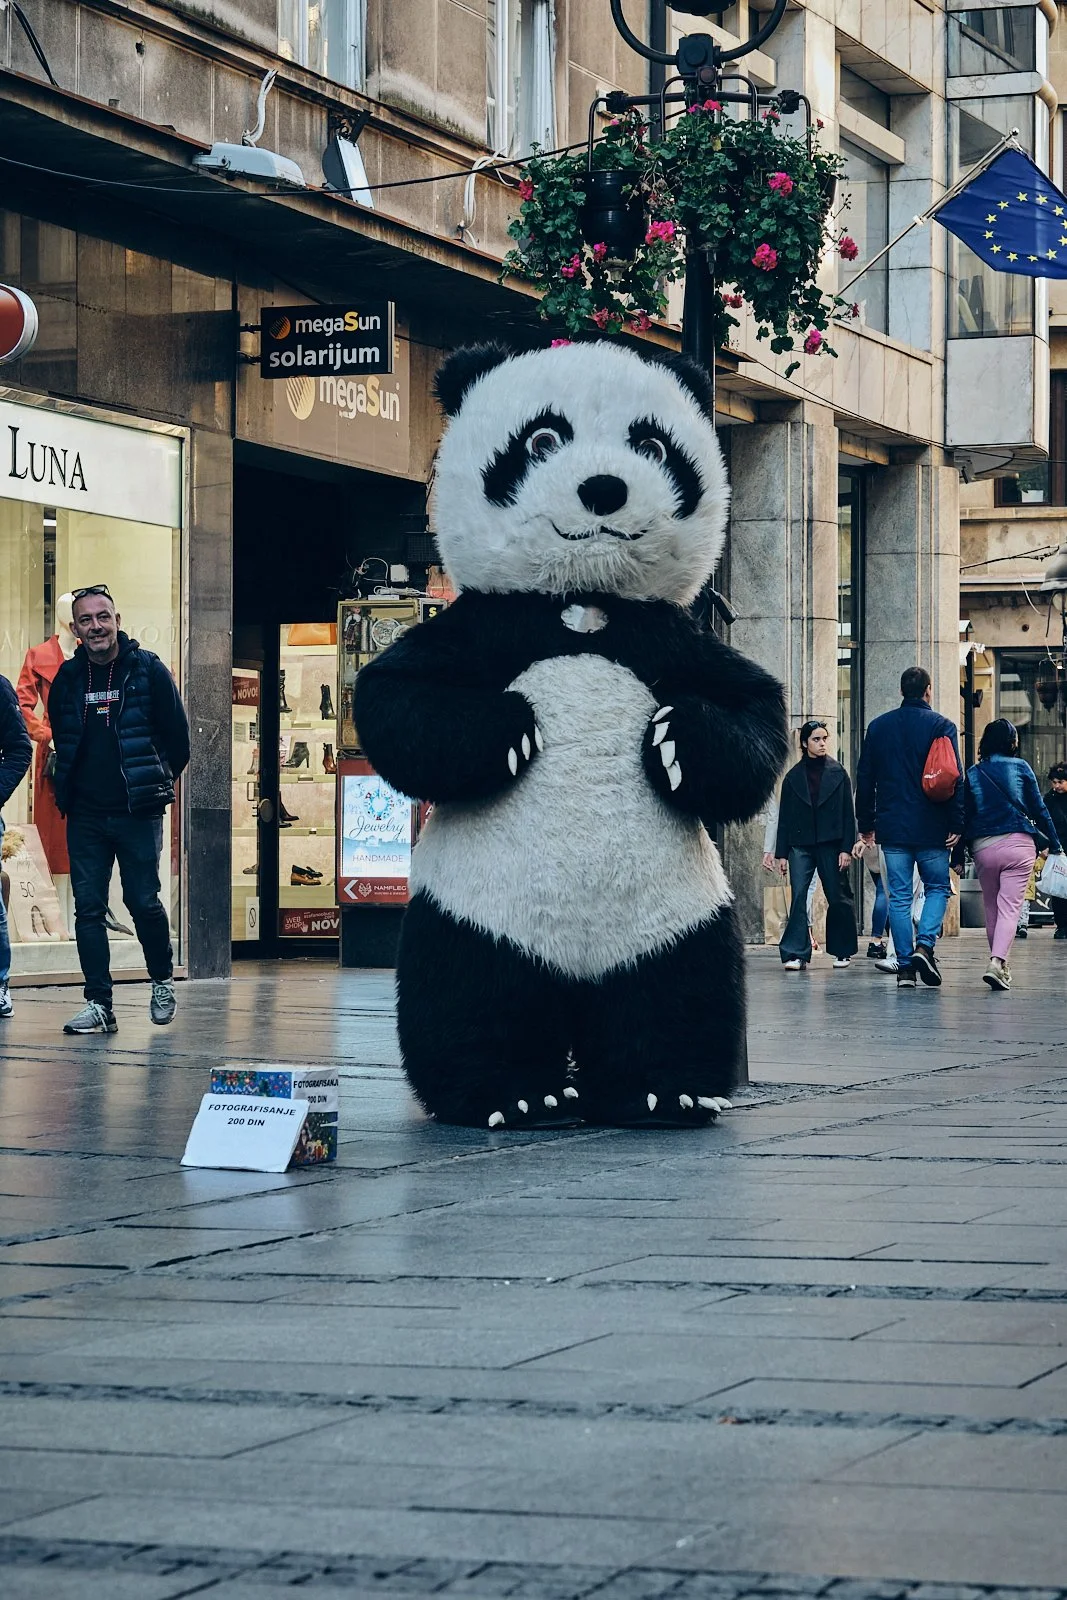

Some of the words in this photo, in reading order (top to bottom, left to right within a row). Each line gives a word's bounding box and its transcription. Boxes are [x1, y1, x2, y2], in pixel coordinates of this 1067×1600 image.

[295, 311, 381, 337] megaSun
[269, 342, 380, 370] solarijum
[319, 375, 400, 422] megaSun
[7, 425, 88, 491] LUNA
[349, 815, 405, 841] Jewelry
[352, 854, 404, 863] HANDMADE
[207, 1104, 297, 1116] FOTOGRAFISANJE
[317, 1095, 328, 1103] DIN
[227, 1117, 245, 1126] 200
[247, 1118, 265, 1127] DIN
